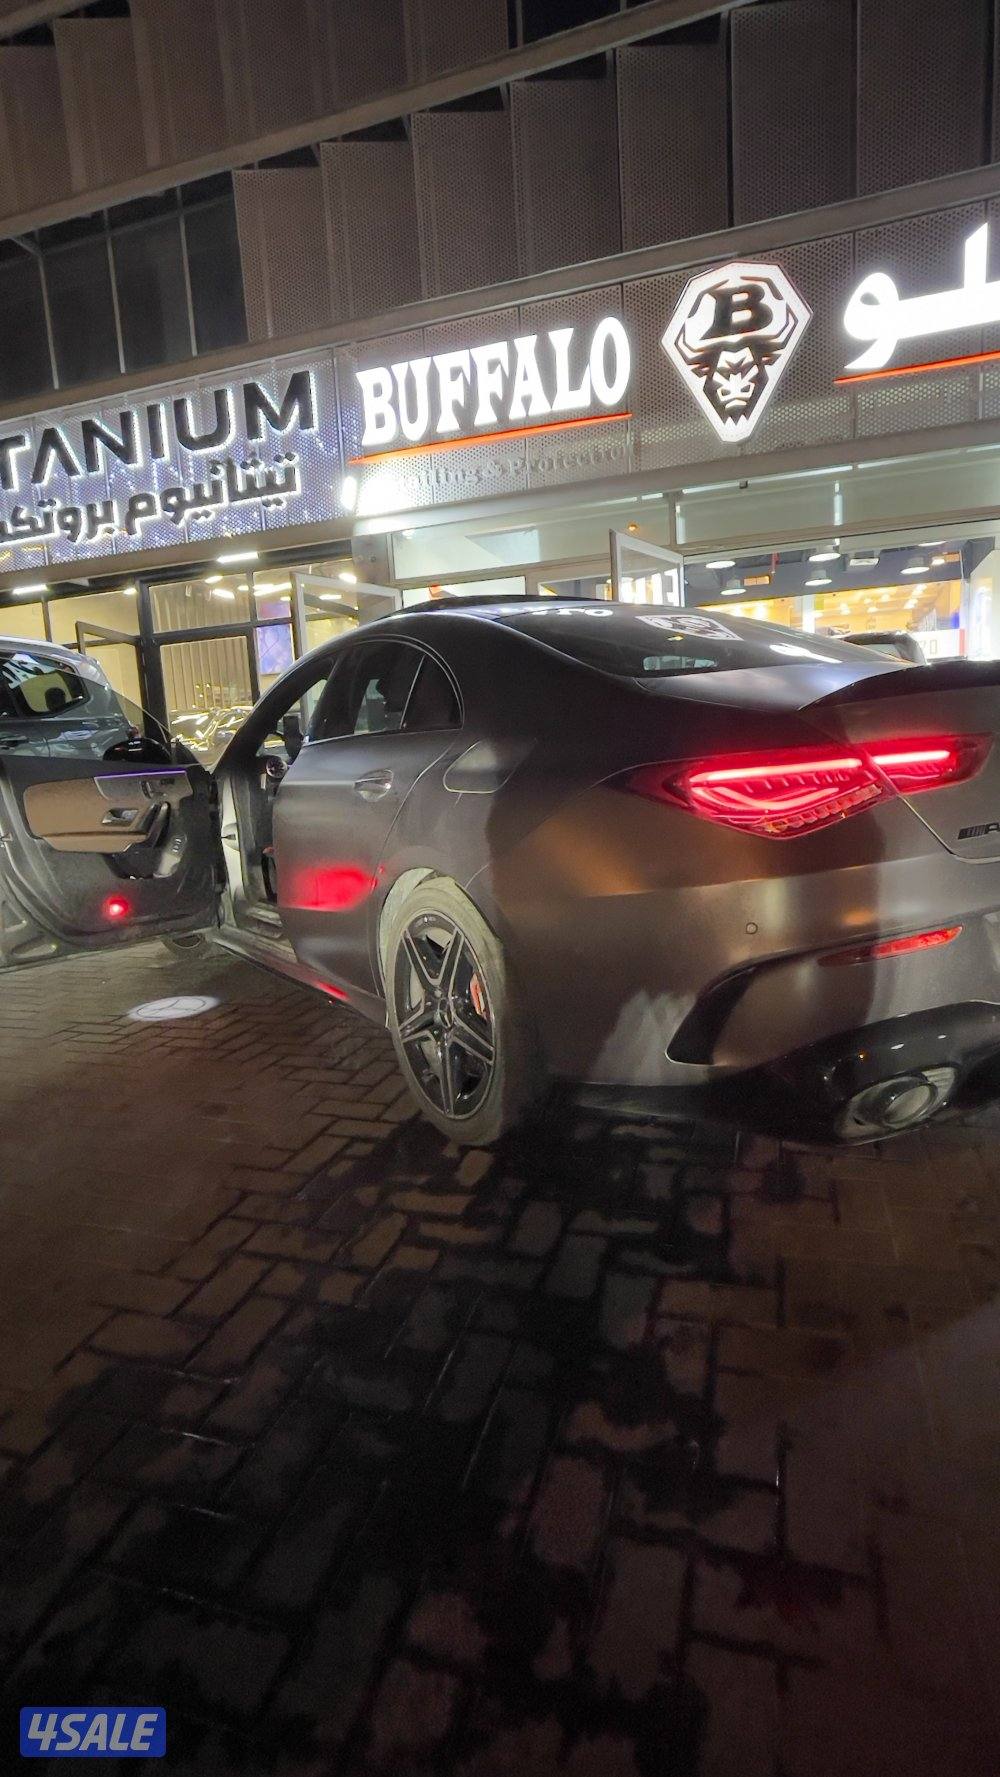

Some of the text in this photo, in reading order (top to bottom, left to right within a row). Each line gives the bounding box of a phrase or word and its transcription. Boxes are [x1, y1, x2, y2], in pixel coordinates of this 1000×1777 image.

[700, 283, 774, 341] B
[356, 316, 631, 446] BUFFALO
[125, 452, 297, 536] تيتانيوم
